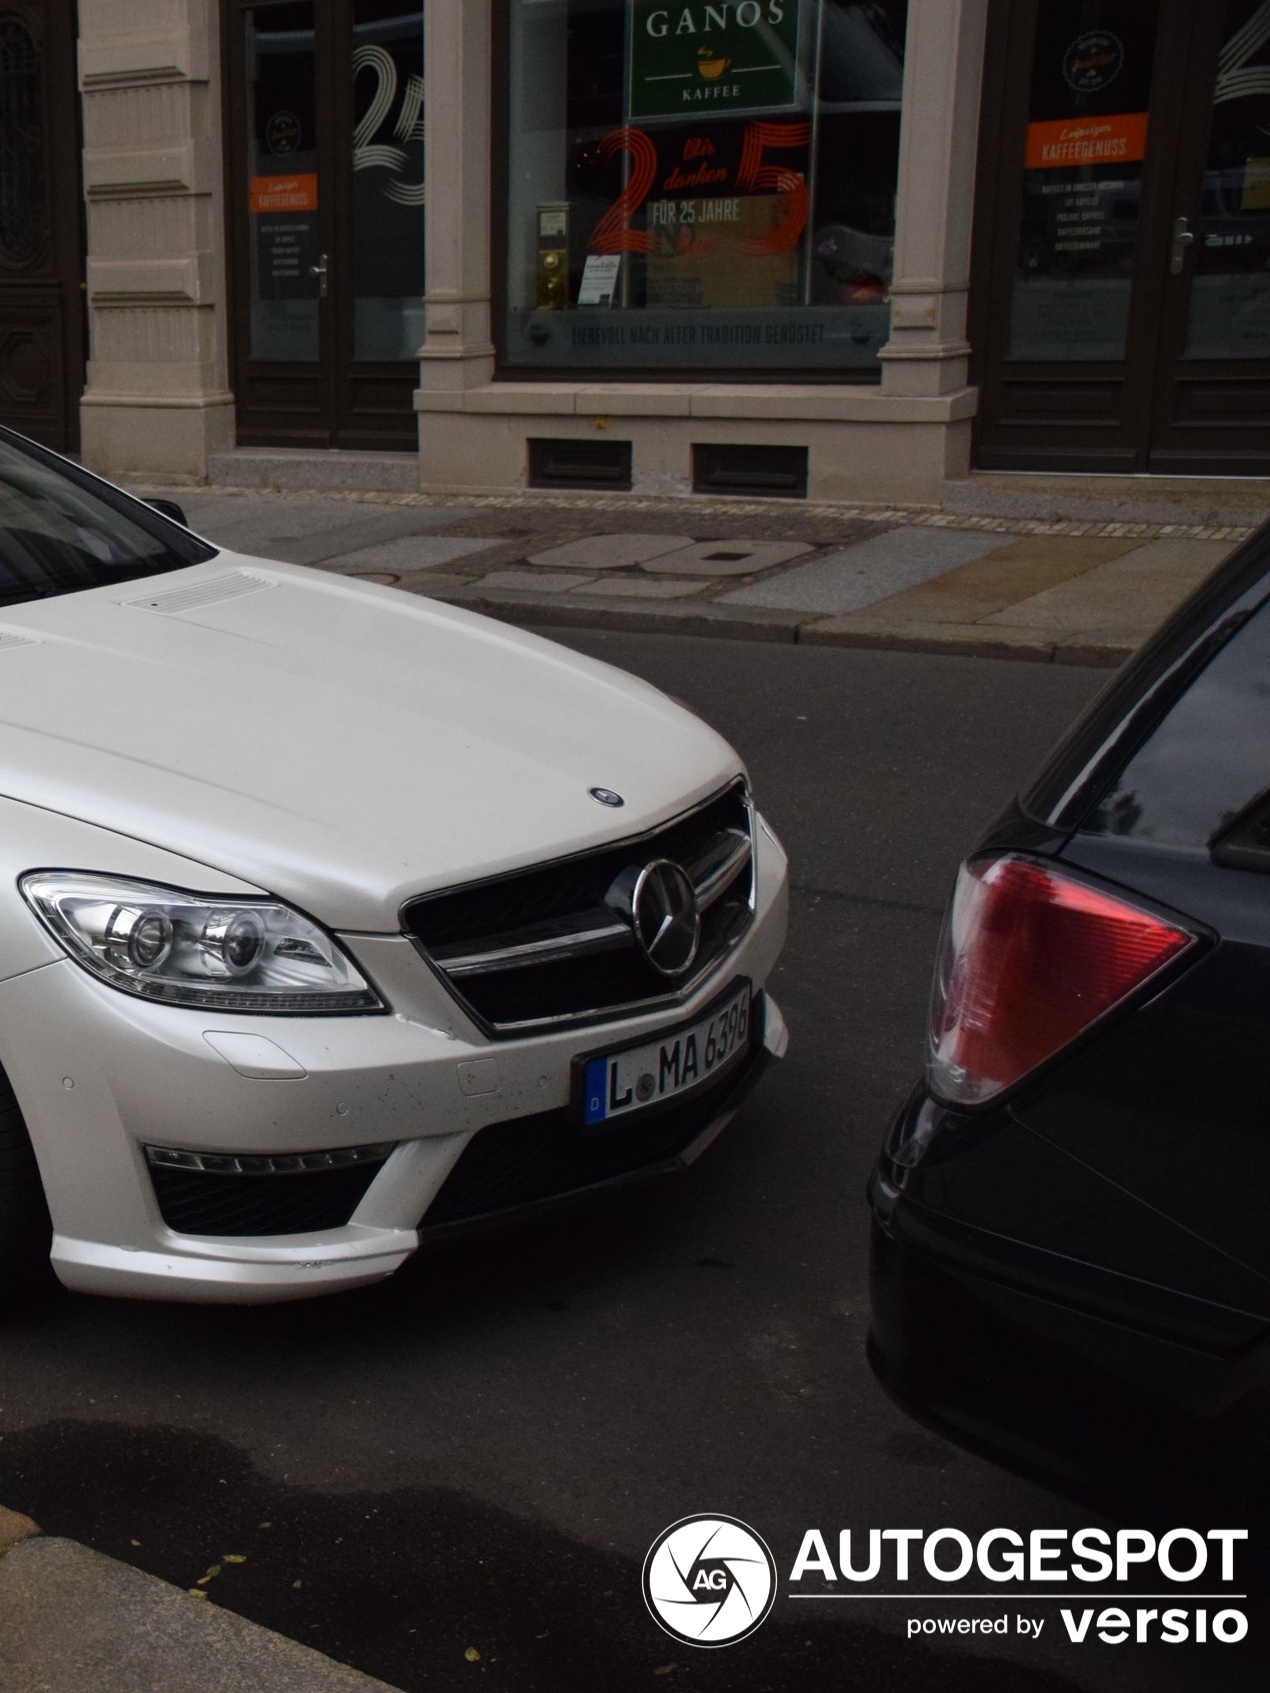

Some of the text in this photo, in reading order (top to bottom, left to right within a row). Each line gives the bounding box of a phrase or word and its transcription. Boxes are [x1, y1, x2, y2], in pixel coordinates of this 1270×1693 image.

[646, 0, 783, 37] GANOS
[682, 85, 740, 101] KAFFEE
[683, 137, 717, 160] Wir
[1042, 138, 1127, 161] KAFFEEGENUSS
[663, 161, 728, 190] danken
[653, 198, 740, 225] FÜR 25 JAHRE
[572, 322, 824, 345] LIEBEVOLL NACH ALTER TRADITION GERÖSTET
[610, 1062, 633, 1109] L
[659, 1034, 698, 1093] MA
